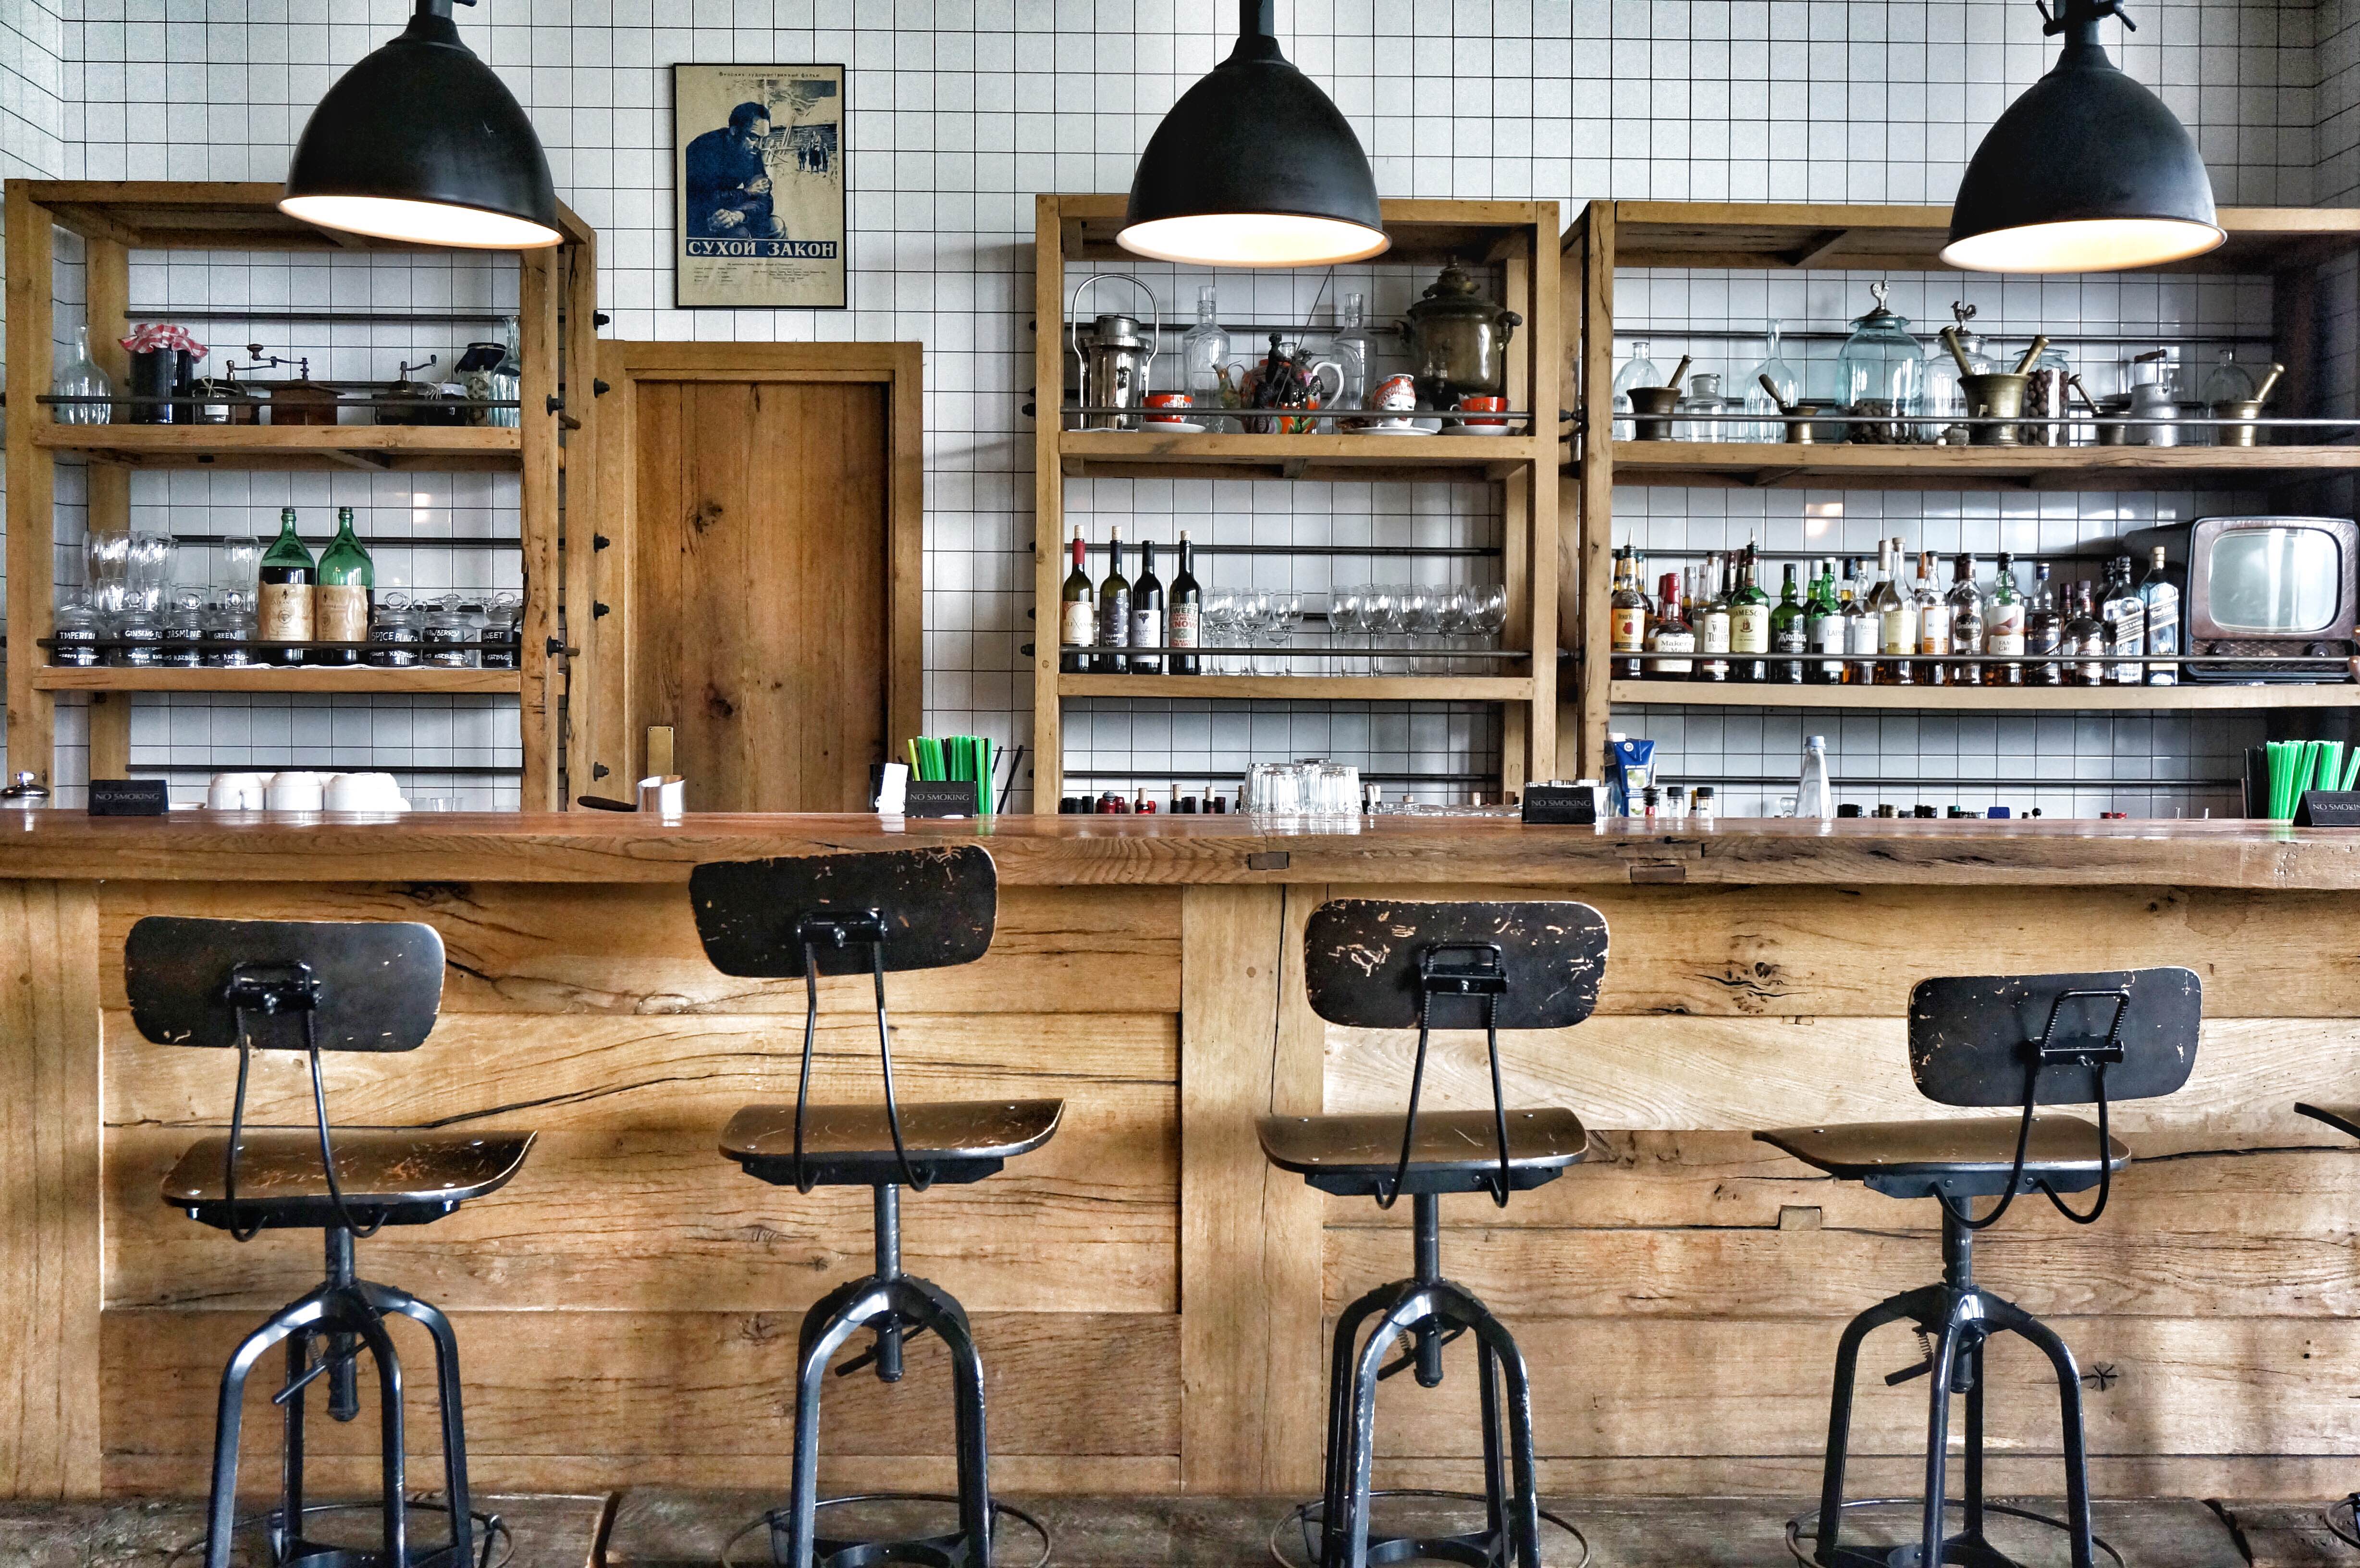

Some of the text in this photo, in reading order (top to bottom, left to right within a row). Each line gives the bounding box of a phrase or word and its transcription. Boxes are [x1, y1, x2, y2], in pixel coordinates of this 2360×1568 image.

[688, 240, 834, 257] СУХОЙ ЗАКОН
[125, 629, 154, 637] GINSENG
[214, 631, 237, 640] GREEN
[371, 632, 394, 641] SPICE
